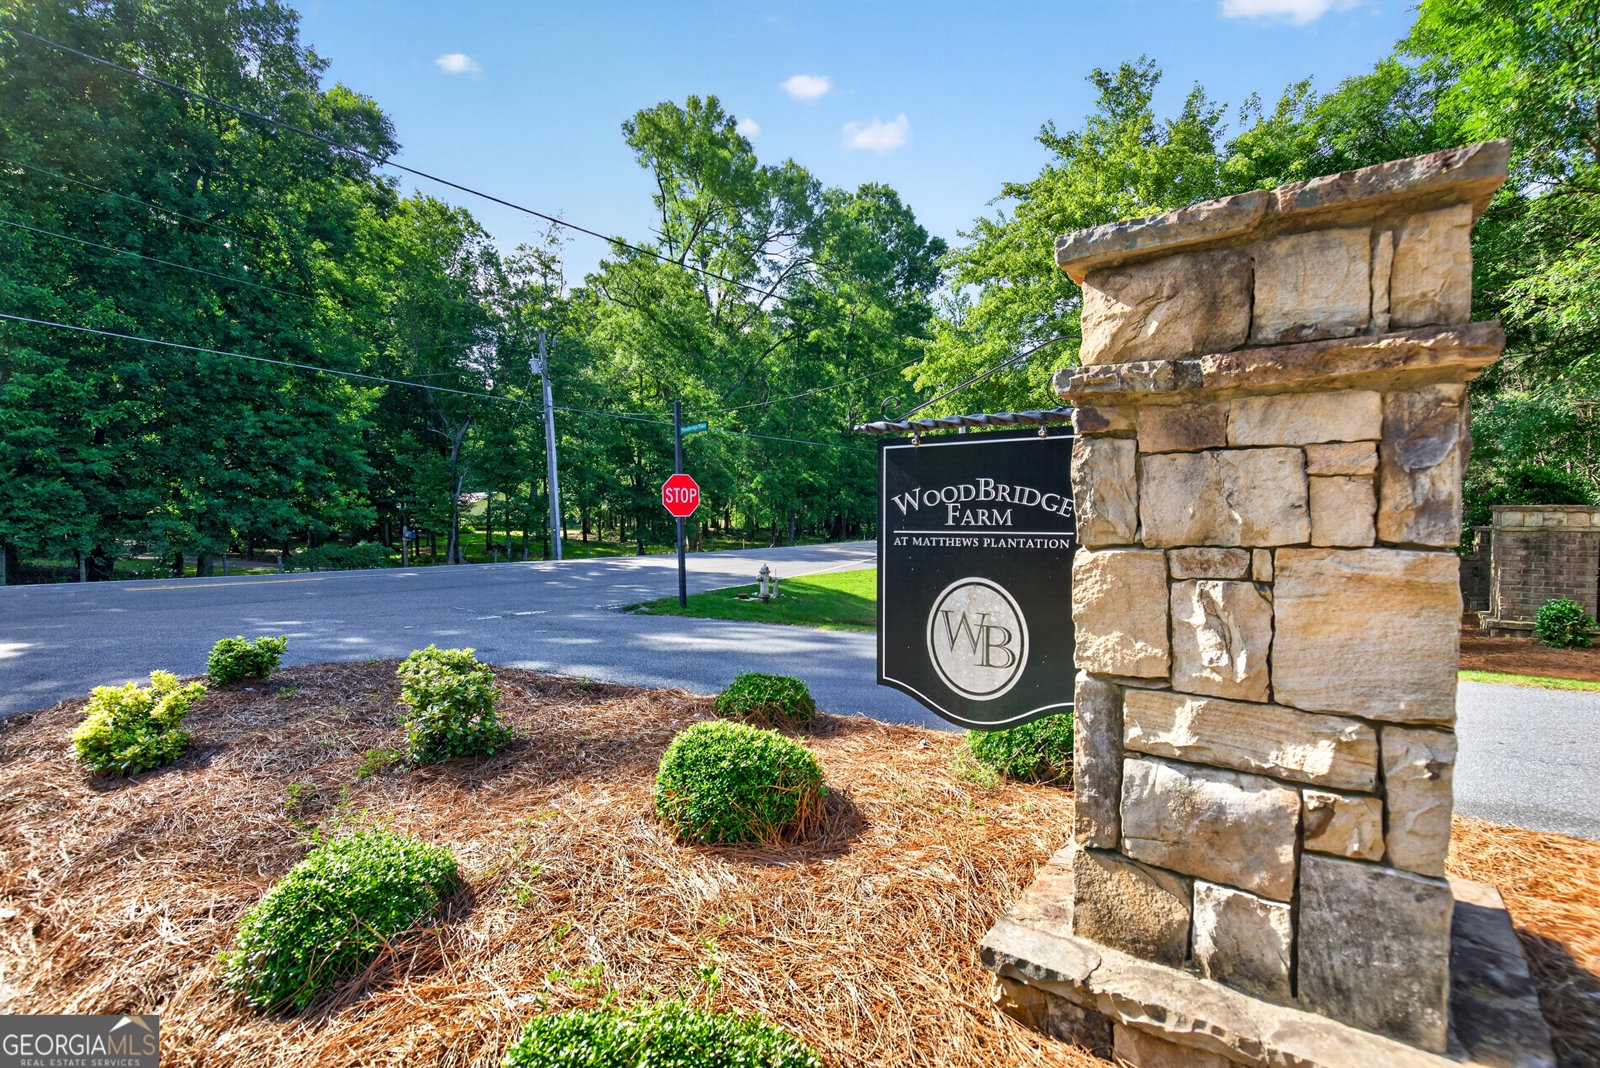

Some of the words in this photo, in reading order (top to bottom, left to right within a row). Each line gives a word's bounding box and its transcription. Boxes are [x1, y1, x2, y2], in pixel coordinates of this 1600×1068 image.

[665, 487, 698, 504] STOP
[891, 477, 1075, 518] WOODBRIDGE
[945, 503, 1014, 526] FARM
[893, 537, 909, 546] AT
[912, 537, 979, 547] MATTHEWS
[983, 538, 1071, 549] PLANTATION
[940, 609, 1016, 669] WB
